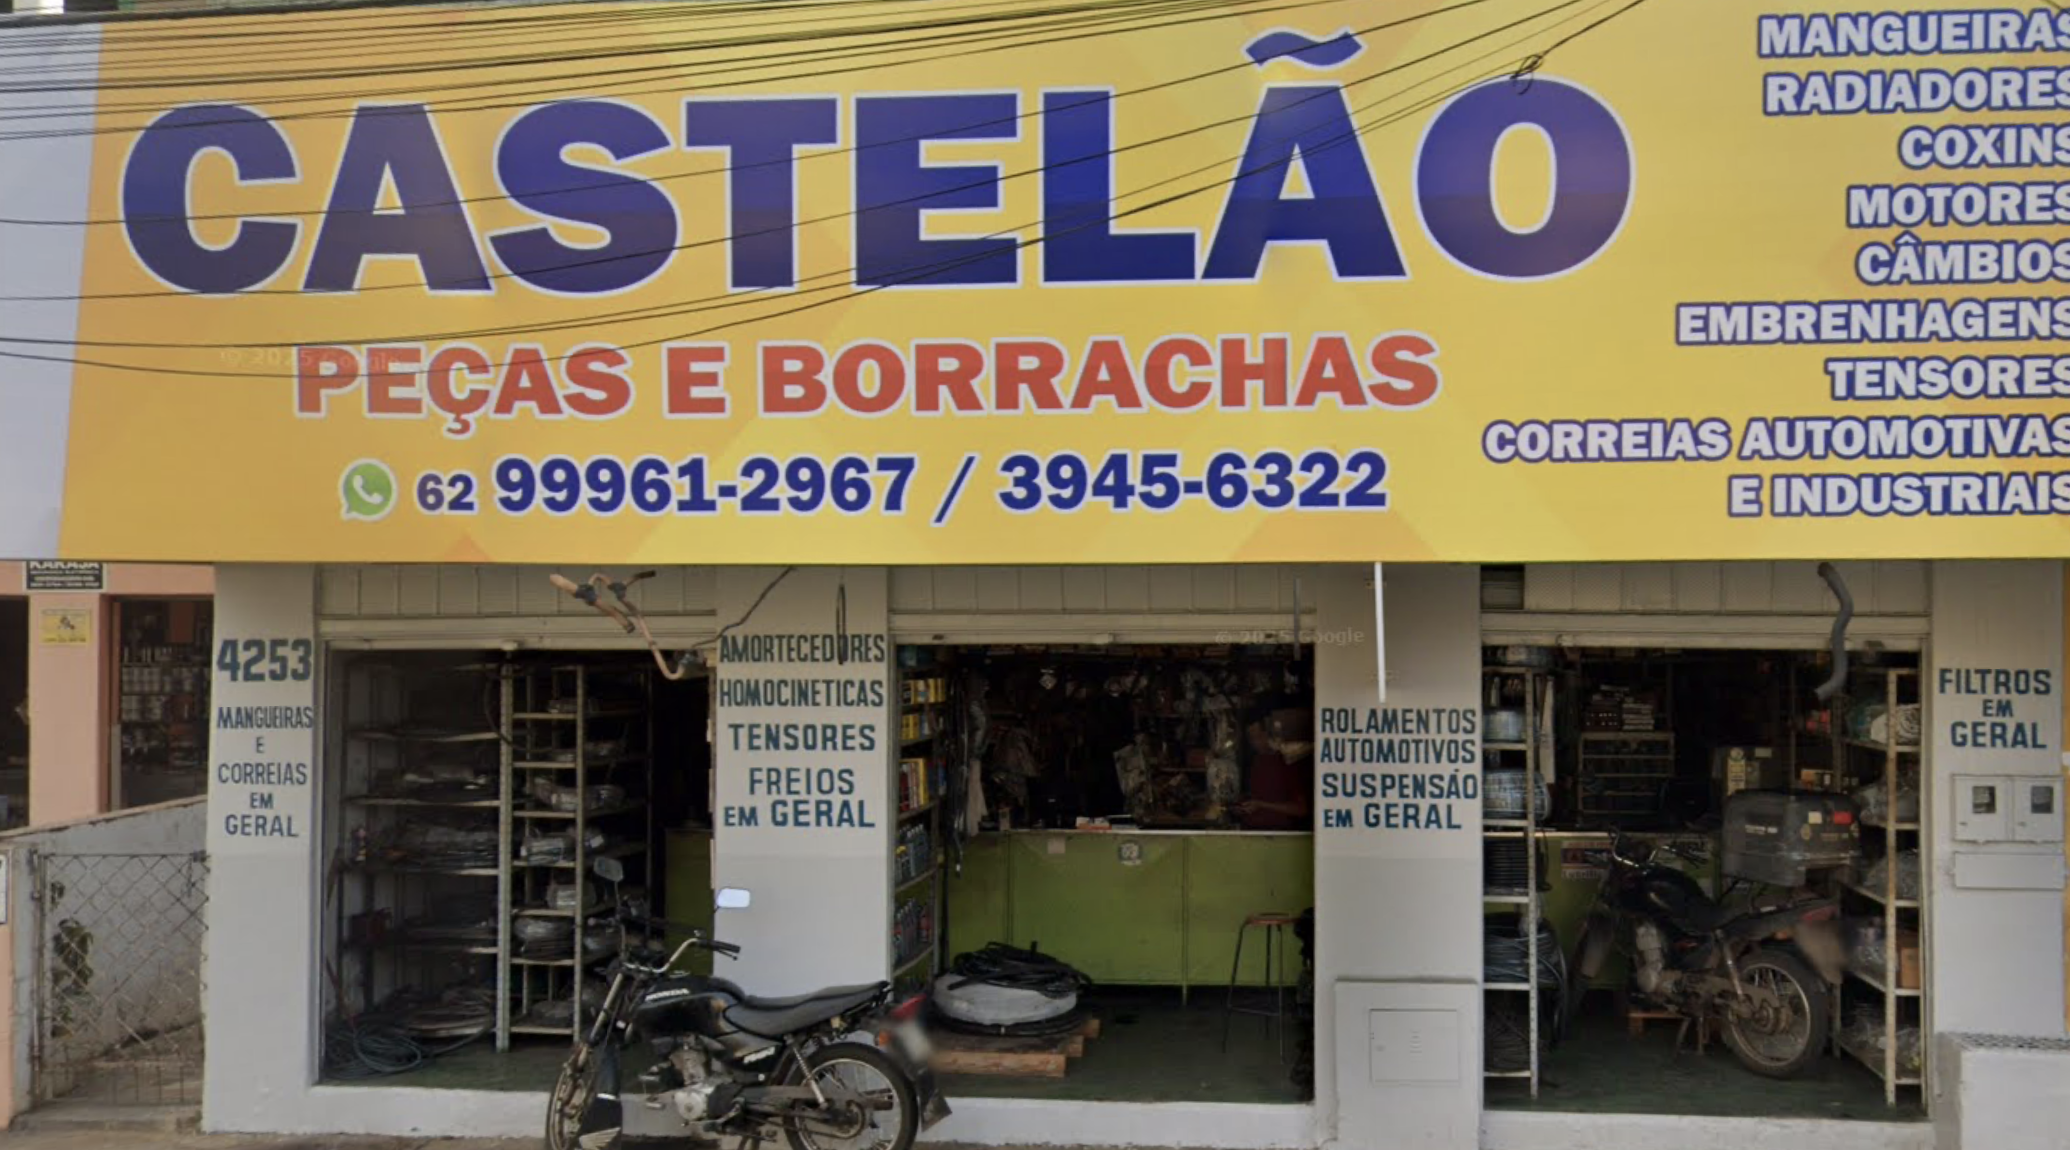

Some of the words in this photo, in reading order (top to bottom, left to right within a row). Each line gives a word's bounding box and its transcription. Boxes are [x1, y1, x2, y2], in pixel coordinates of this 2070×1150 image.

[1899, 124, 2070, 170] COXINS
[120, 28, 1637, 298] CASTELÃO
[1847, 181, 2070, 228] MOTORES
[1855, 230, 2070, 285] CÂMBIOS
[1676, 297, 2070, 345] EMBRENHAGENS
[294, 342, 635, 436] PEÇAS
[664, 342, 731, 417] E
[758, 332, 1441, 417] BORRACHAS
[1825, 356, 2070, 400] TENSORES
[1482, 417, 1732, 463] CORREIAS
[1737, 413, 2070, 461] AUTOMOTIVAS
[414, 471, 480, 515] 62
[493, 453, 919, 515] 99961-2967
[930, 452, 979, 527] /
[995, 447, 1390, 514] 3945-6322
[1728, 475, 1763, 516] E
[1770, 472, 2070, 516] INDUSTRIAIS
[216, 637, 313, 683] 4253
[719, 633, 886, 664] AMORTECEDORES
[719, 678, 885, 708] HOMOCINETICAS
[1938, 667, 2053, 696] FILTROS
[217, 705, 314, 730] MANGUEIRAS
[1320, 706, 1477, 735] ROLAMENTOS
[1981, 698, 2014, 718] EM
[255, 735, 265, 754] E
[727, 723, 876, 752] TENSORES
[1950, 721, 2048, 749] GERAL
[1320, 737, 1476, 764] AUTOMOTIVOS
[217, 761, 309, 786] CORREIAS
[748, 766, 855, 796] FREIOS
[1321, 768, 1478, 799] SUSPENSÃO
[249, 791, 275, 810] EM
[723, 806, 760, 828] EM
[770, 798, 876, 828] GERAL
[224, 813, 300, 839] GERAL
[1322, 807, 1355, 829] EM
[1363, 801, 1463, 831] GERAL
